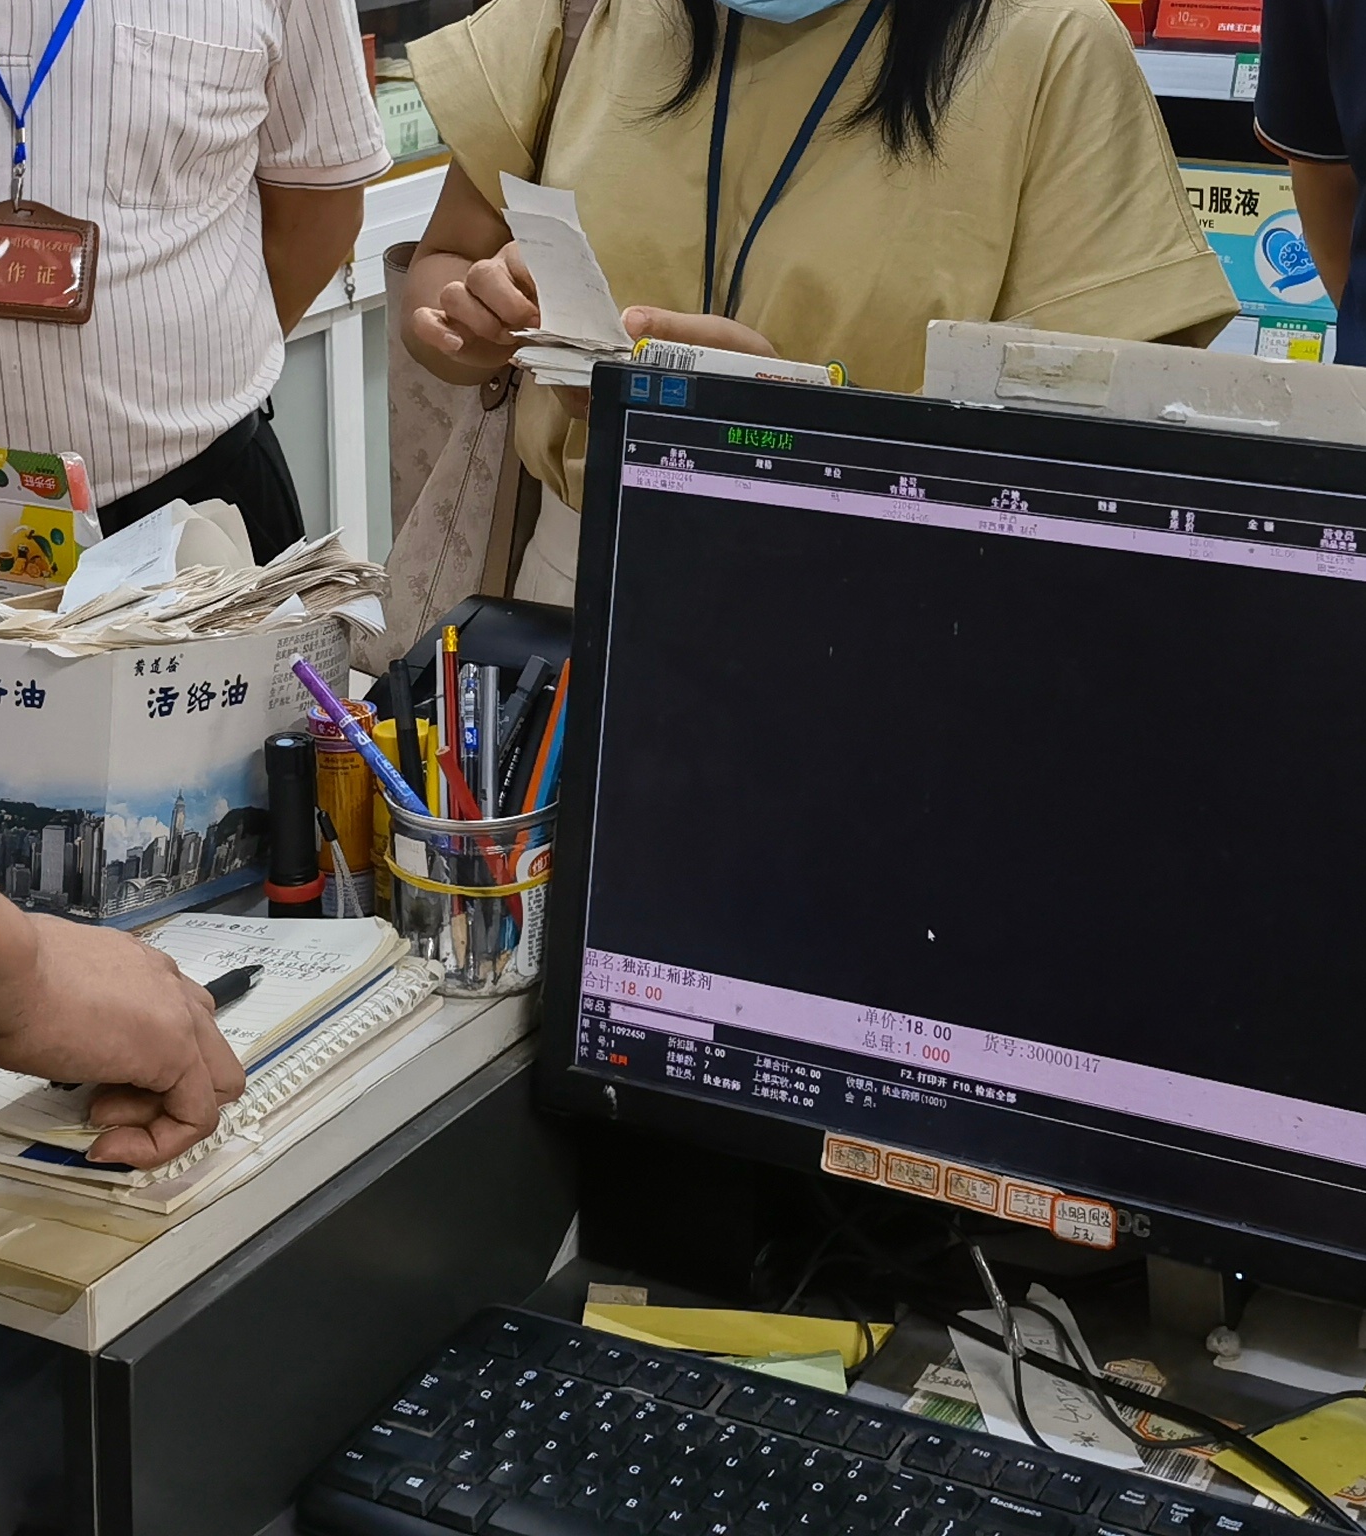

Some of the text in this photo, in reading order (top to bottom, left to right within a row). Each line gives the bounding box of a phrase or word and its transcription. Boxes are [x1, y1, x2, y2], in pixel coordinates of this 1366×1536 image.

[1186, 186, 1260, 217] 口服液
[727, 426, 794, 451] 健民药店
[146, 674, 249, 720] 活络油
[583, 971, 663, 1001] 合计:18.00
[864, 1008, 952, 1042] 单价:18.00
[704, 1045, 726, 1058] 0.00
[861, 1030, 951, 1064] 总量:1.000
[982, 1033, 1101, 1074] 货号:30000147
[703, 1060, 709, 1069] 7
[703, 1073, 741, 1091] 执业药师
[1116, 1208, 1151, 1238] OC
[990, 1496, 1042, 1518] Backspace
